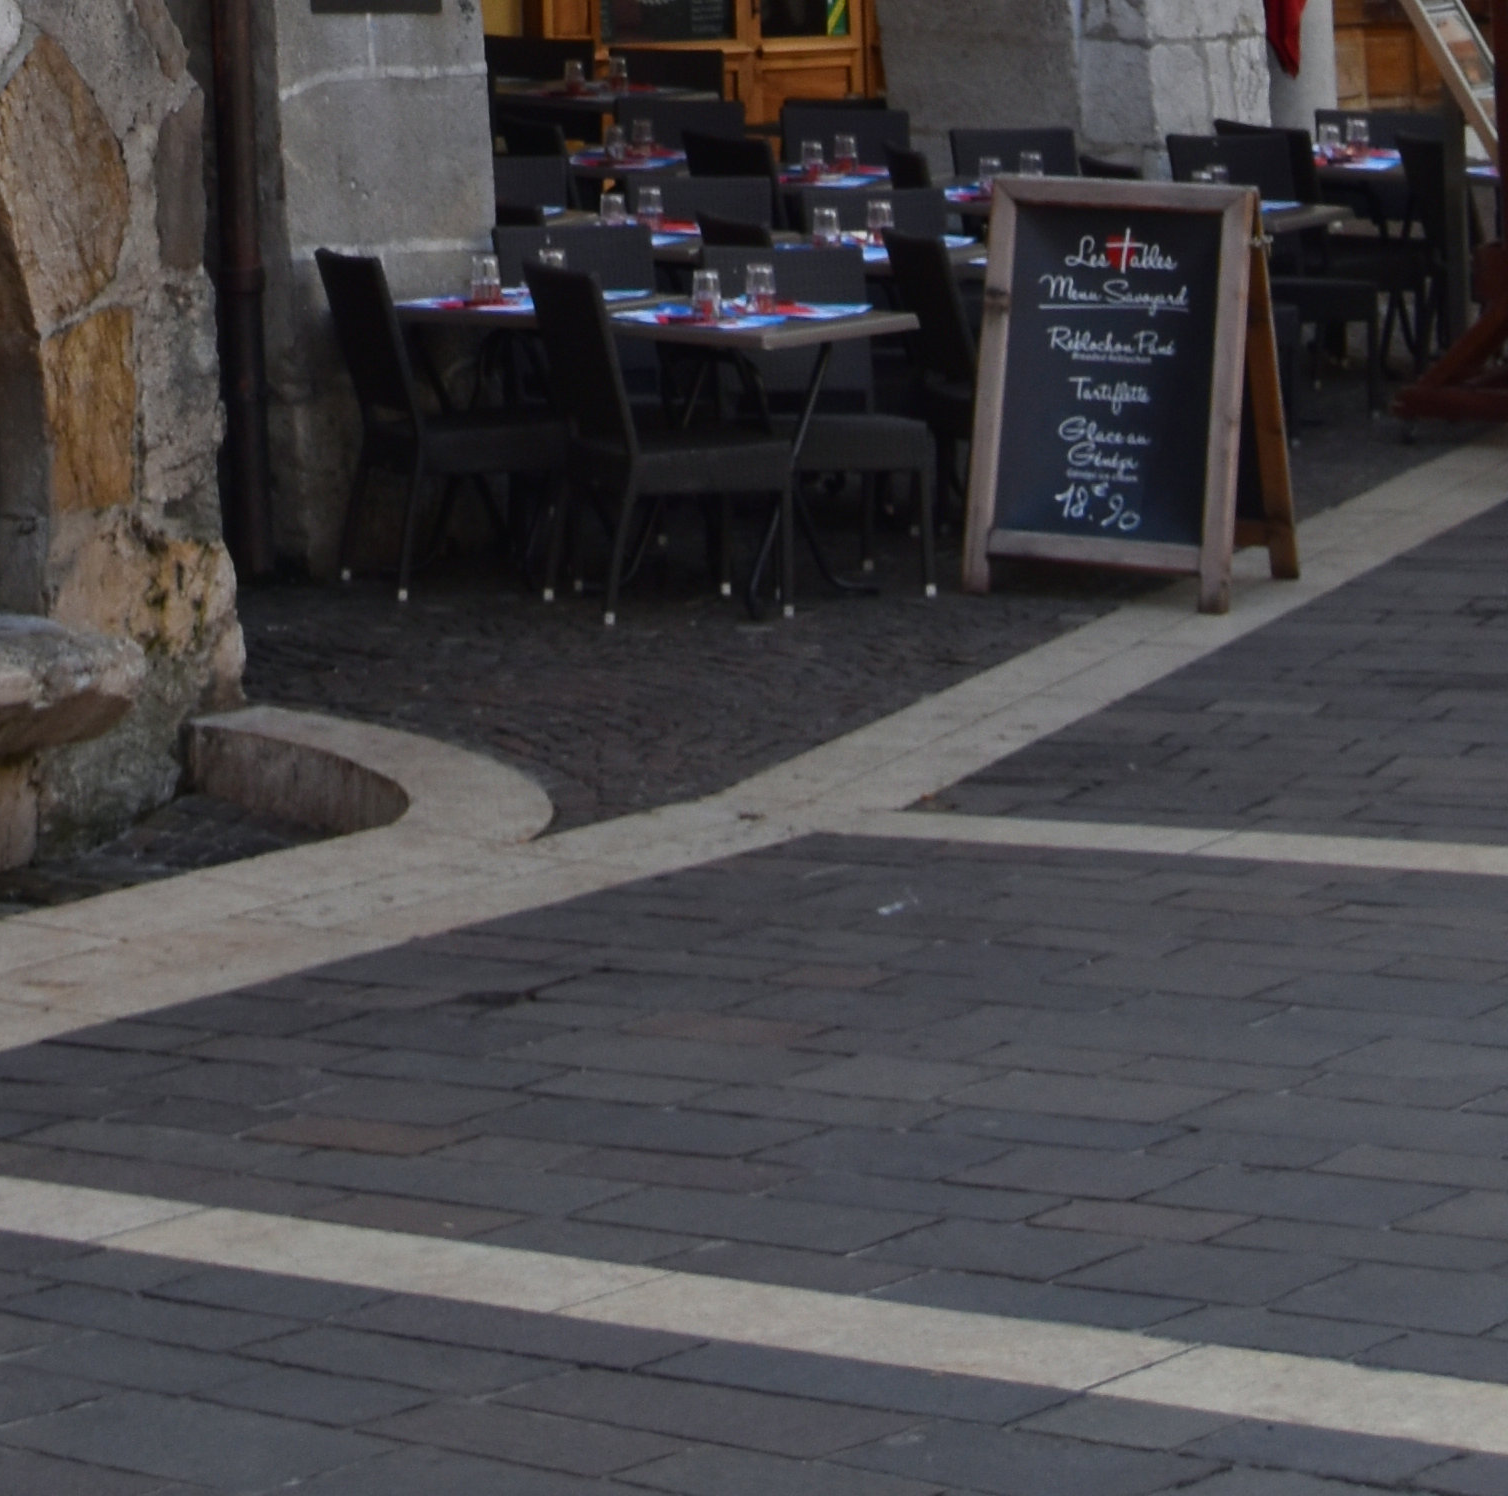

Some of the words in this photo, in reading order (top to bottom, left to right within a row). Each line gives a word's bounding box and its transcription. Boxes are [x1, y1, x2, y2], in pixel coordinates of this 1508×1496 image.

[1064, 235, 1110, 268] Les
[1039, 274, 1102, 301] Menu
[1103, 279, 1189, 317] Savoyard
[1068, 376, 1151, 416] Tartiflette
[1058, 415, 1125, 446] Glace
[1126, 432, 1152, 446] au
